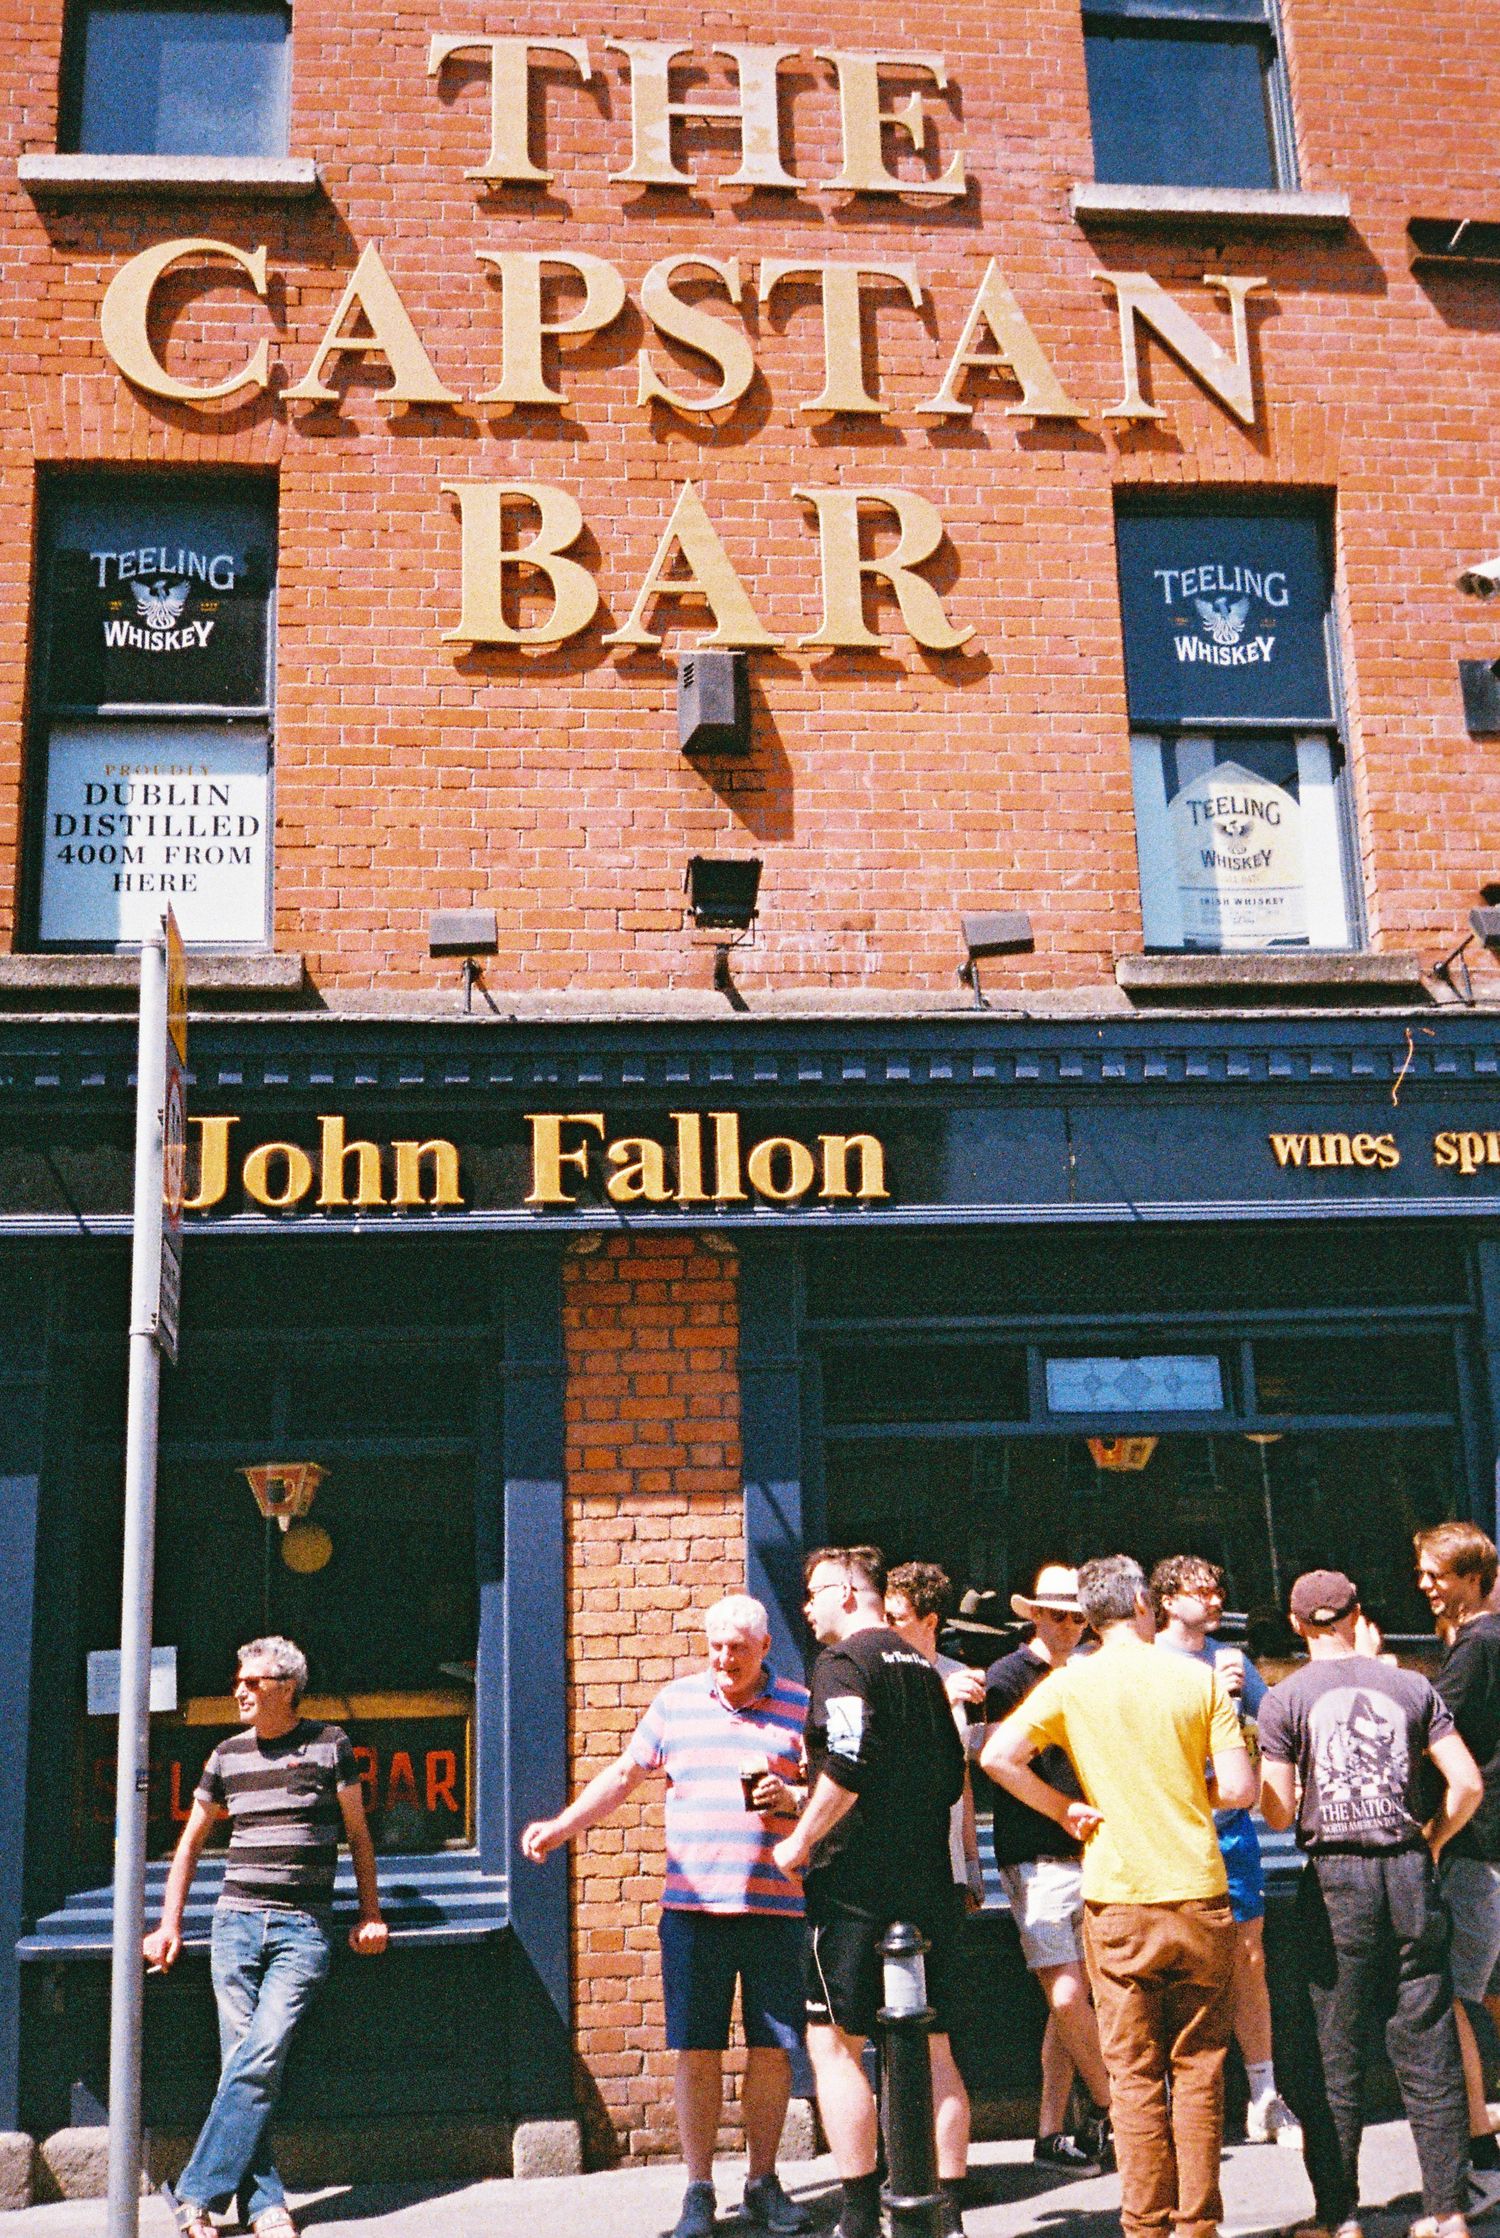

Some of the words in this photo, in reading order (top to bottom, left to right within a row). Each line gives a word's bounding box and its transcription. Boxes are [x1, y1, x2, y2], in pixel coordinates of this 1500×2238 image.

[427, 33, 968, 196] THE
[100, 238, 1268, 425] CAPSTAN
[89, 547, 235, 591] TEELING
[440, 478, 977, 651] BAR
[1153, 564, 1289, 607] TEELING
[103, 620, 215, 652] WHISKEY
[1173, 636, 1276, 666] WHISKEY
[84, 783, 231, 807] DUBLIN
[53, 813, 260, 838] DISTILLED
[1186, 796, 1281, 826] TEELING
[57, 844, 145, 866] 400M
[164, 846, 252, 866] FROM
[1200, 849, 1272, 871] WHISKEY
[113, 873, 198, 893] HERE
[1234, 897, 1285, 906] WHISKEY
[181, 1115, 465, 1208] John
[524, 1111, 891, 1204] Fallon
[1268, 1132, 1401, 1170] wines
[1319, 1802, 1349, 1821] THE
